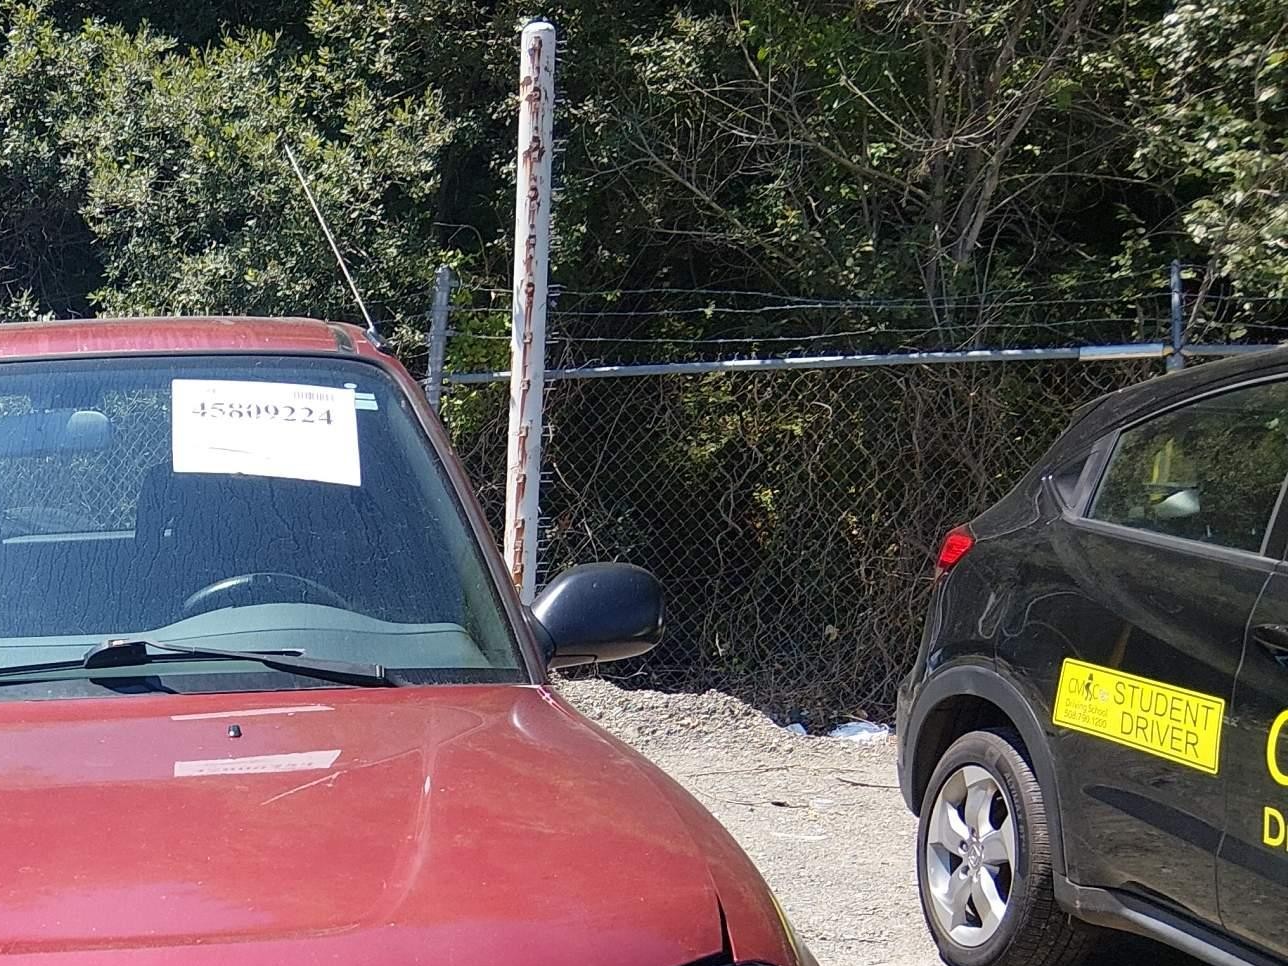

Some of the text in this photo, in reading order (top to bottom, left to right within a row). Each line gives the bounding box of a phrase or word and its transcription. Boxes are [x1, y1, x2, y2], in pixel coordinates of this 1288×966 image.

[1113, 681, 1215, 731] STUDENT
[1120, 711, 1199, 758] DRIVER
[1263, 807, 1288, 852] D
